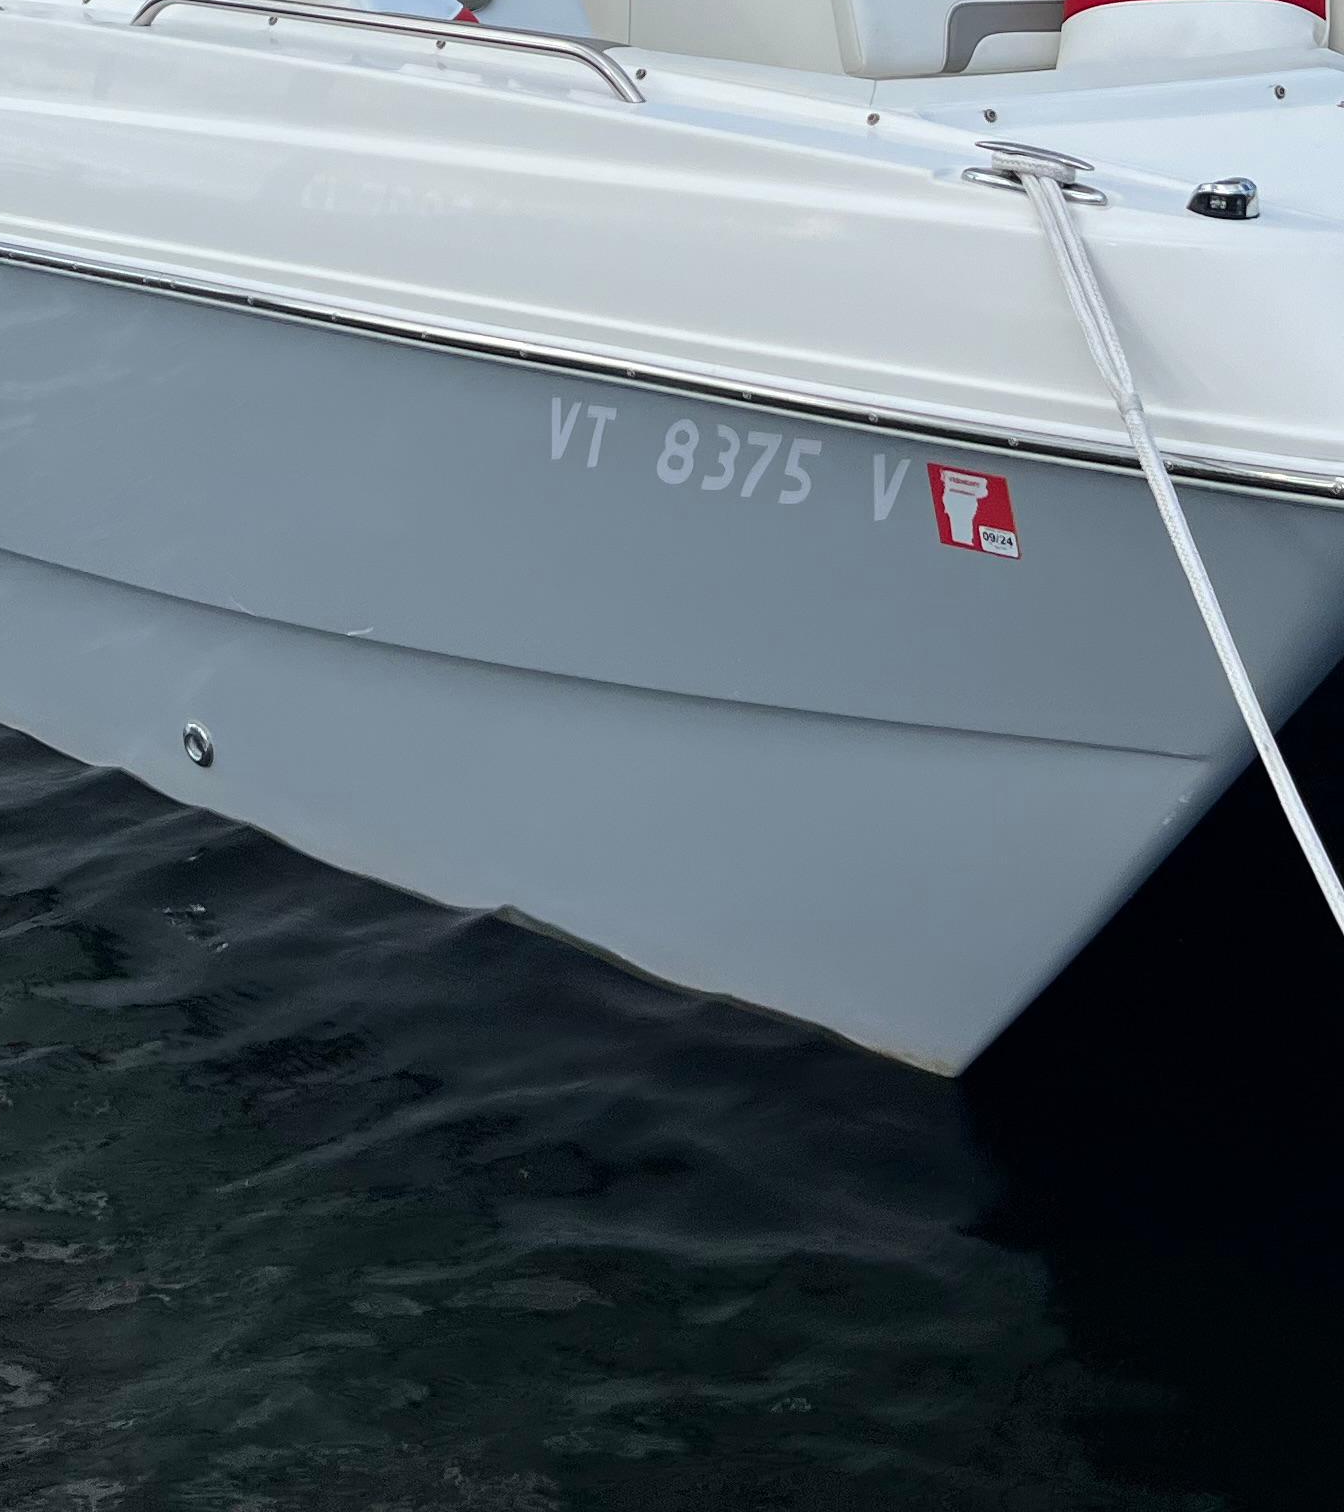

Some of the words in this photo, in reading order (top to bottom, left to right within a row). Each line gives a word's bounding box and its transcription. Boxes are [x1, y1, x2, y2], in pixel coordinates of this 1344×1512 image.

[550, 397, 617, 468] VT
[656, 418, 822, 505] 8375
[873, 454, 911, 522] V
[982, 531, 1013, 547] 09/24
